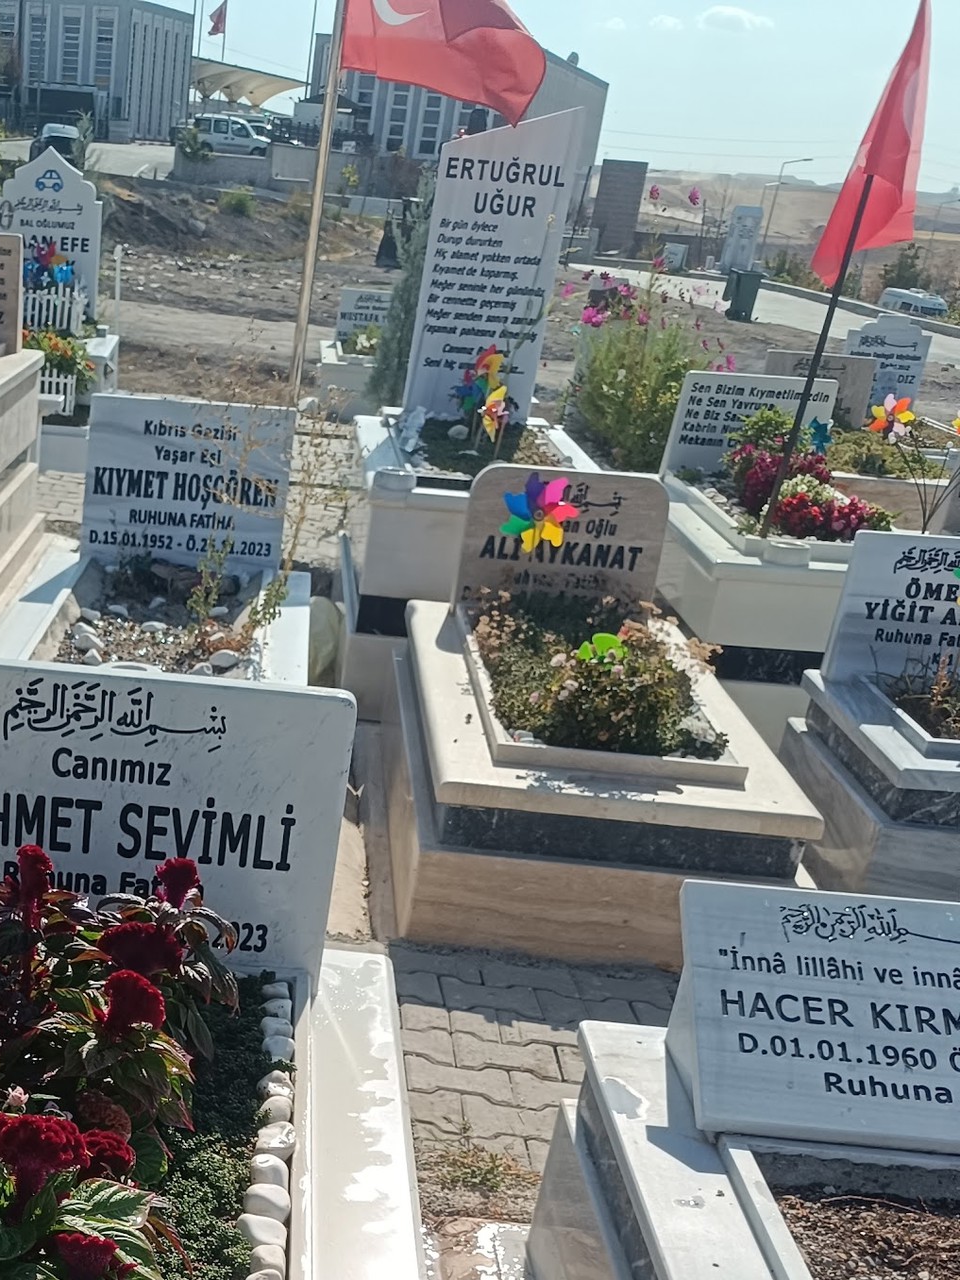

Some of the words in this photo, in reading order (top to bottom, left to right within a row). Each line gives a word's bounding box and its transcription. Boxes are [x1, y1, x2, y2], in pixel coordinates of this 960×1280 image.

[445, 156, 565, 188] ERTUĞRUL
[473, 188, 536, 218] UĞUR
[60, 236, 90, 253] EFE
[437, 233, 463, 246] Durup
[688, 395, 703, 407] Ne
[706, 397, 726, 408] Sen
[691, 382, 711, 394] Sen
[715, 384, 745, 397] Bizim
[749, 387, 830, 404] Kıymetlimzdin
[685, 408, 700, 420] Ne
[703, 409, 721, 421] Biz
[144, 420, 187, 438] Kıbrıs
[681, 421, 717, 434] Kabrin
[678, 434, 724, 448] Mekanın
[155, 445, 195, 465] Yaşar
[200, 449, 221, 468] Eşi
[92, 466, 169, 501] KIYMET
[129, 509, 187, 527] RUHUNA
[190, 511, 236, 531] FATİHA
[585, 518, 618, 539] Oğlu
[904, 577, 960, 602] ÖME
[865, 598, 935, 624] YİĞİT
[940, 607, 960, 626] A
[874, 628, 932, 646] Ruhuna
[51, 747, 172, 787] Canımız
[116, 796, 297, 872] SEVİMLİ
[796, 956, 864, 981] lillâhi
[874, 966, 904, 985] ve
[720, 989, 854, 1028] HACER
[870, 1001, 960, 1036] KIRM
[738, 1032, 937, 1071] D.01.01.1960
[823, 1071, 954, 1105] Ruhuna
